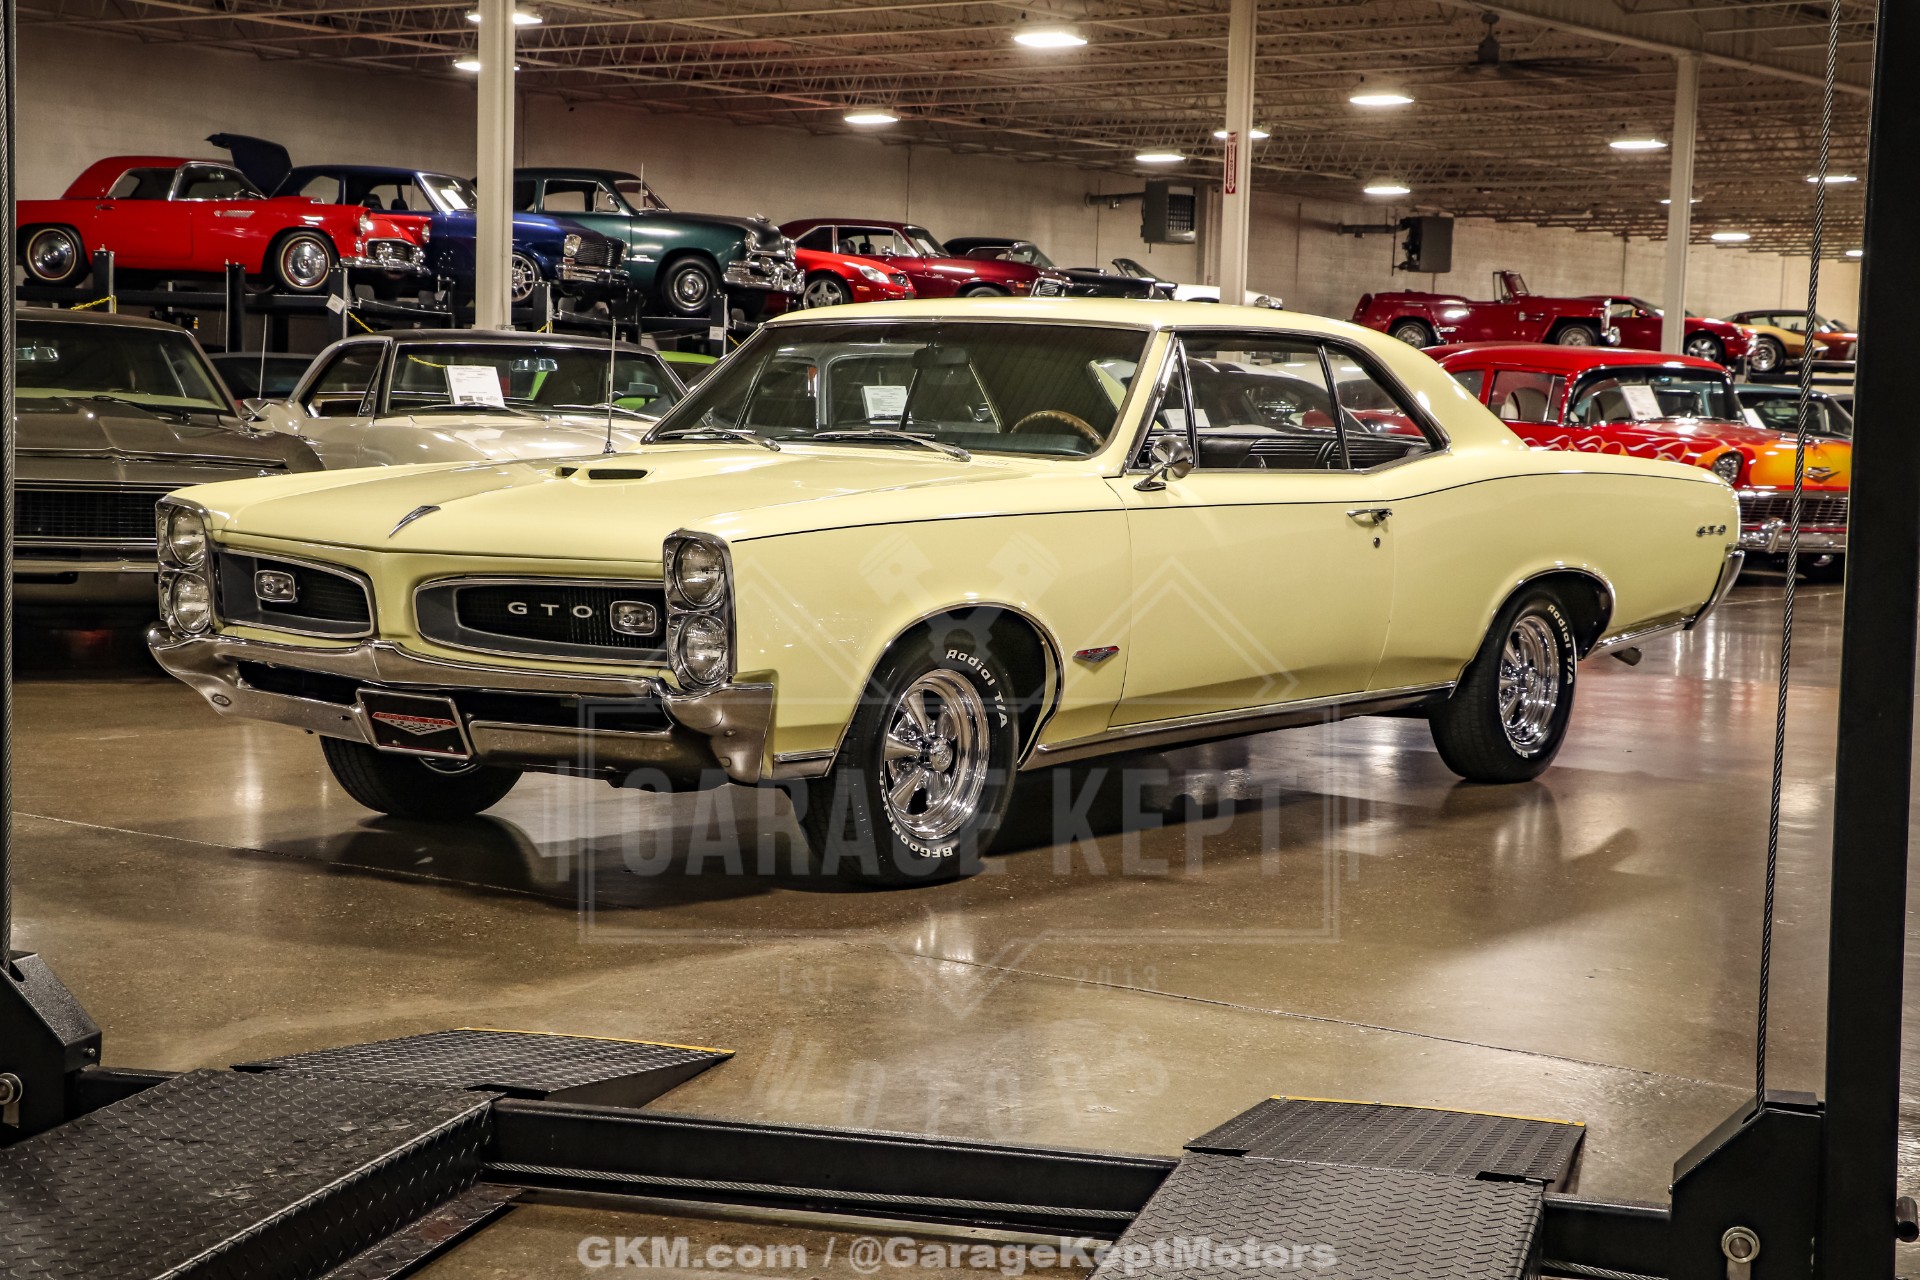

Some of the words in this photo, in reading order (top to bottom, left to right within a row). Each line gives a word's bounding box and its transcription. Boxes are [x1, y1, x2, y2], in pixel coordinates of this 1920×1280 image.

[507, 601, 593, 618] GTO
[1547, 604, 1571, 648] Radial
[1566, 655, 1574, 685] T/A
[945, 649, 996, 686] Radial
[994, 690, 1008, 728] T/A
